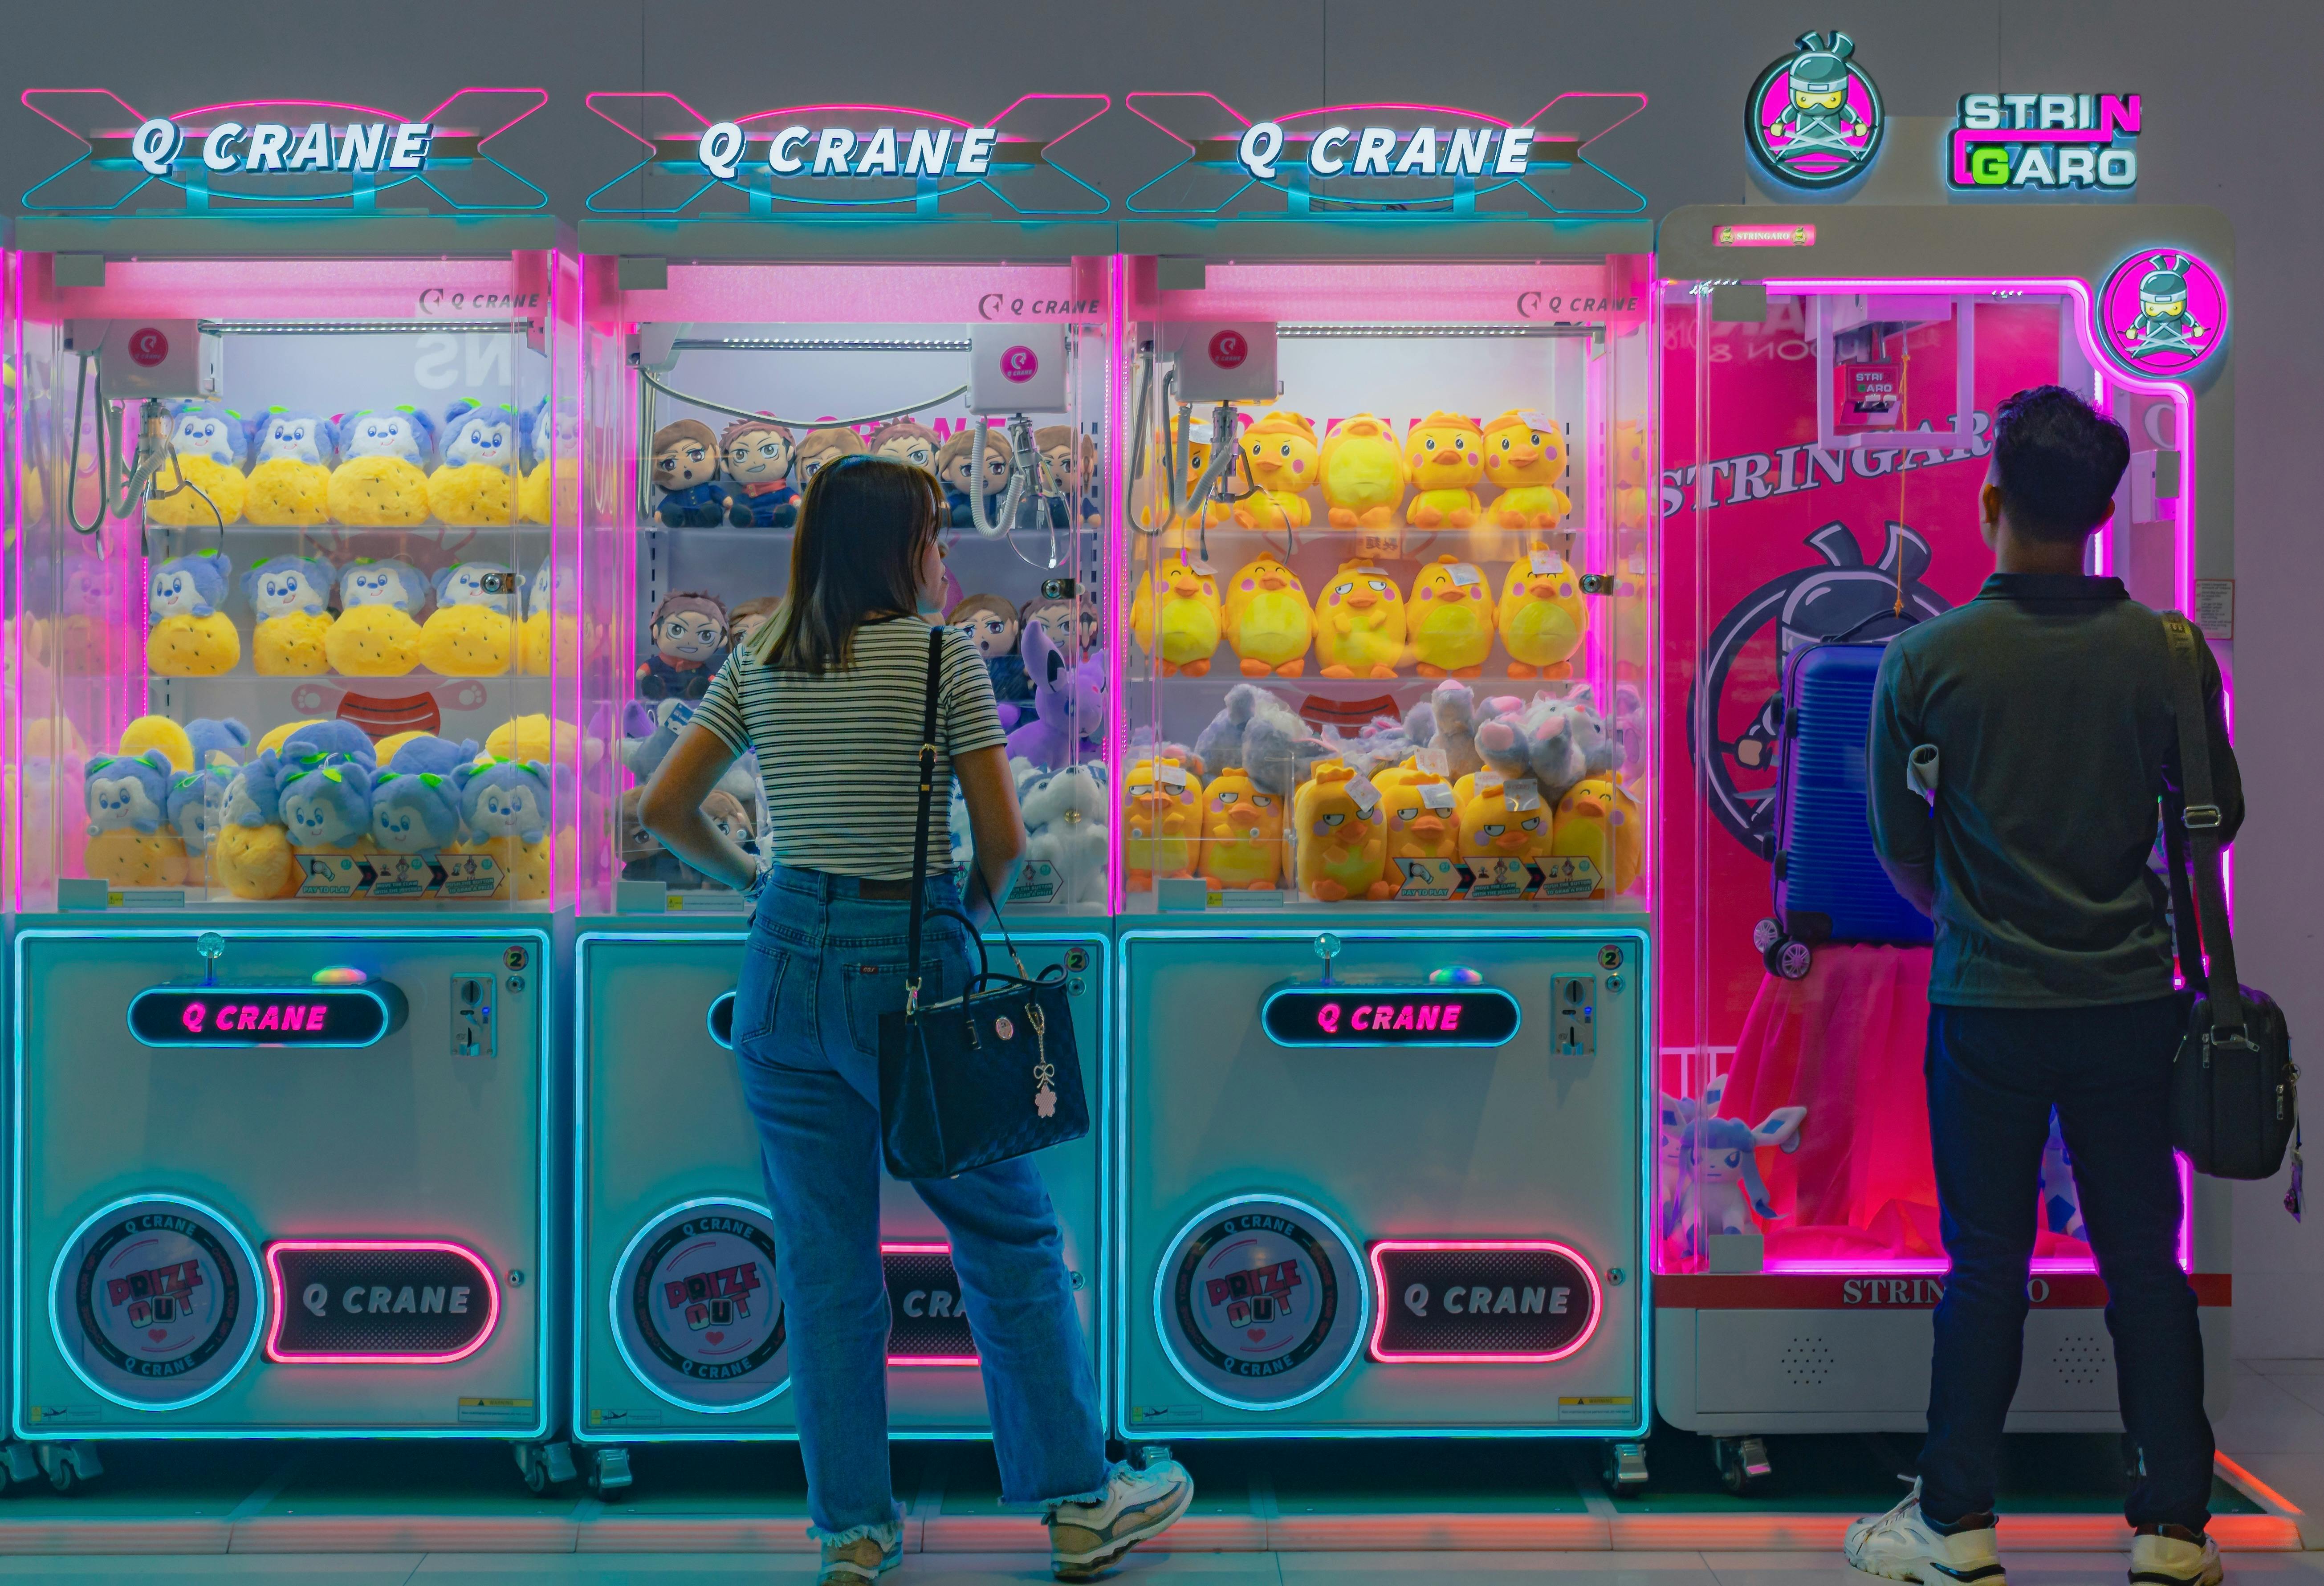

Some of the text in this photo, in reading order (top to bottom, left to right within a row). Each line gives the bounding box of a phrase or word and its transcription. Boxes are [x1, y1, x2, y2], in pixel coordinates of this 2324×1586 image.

[1963, 93, 2141, 132] STRIN
[132, 118, 434, 177] Q CRANE
[699, 122, 998, 178] Q CRANE
[1237, 122, 1535, 178] Q CRANE
[1971, 148, 2137, 185] GARO
[1737, 232, 1790, 240] STRINGARO
[452, 293, 540, 310] Q CRANE
[1011, 299, 1100, 316] Q CRANE
[1549, 297, 1638, 313] Q CRANE
[1856, 373, 1892, 381] STRI
[510, 952, 522, 967] 2
[1070, 954, 1083, 968] 2
[1605, 952, 1616, 965] 2
[183, 1003, 328, 1033] Q CRANE
[1318, 1003, 1462, 1033] Q CRANE
[126, 1216, 196, 1236] Q CRANE
[683, 1218, 754, 1238] Q CRANE
[1224, 1216, 1294, 1236] Q CRANE
[107, 1259, 203, 1307] PRIZE
[664, 1262, 761, 1309] PRIZE
[1206, 1259, 1302, 1307] PRIZE
[1844, 1279, 2049, 1304] STRINO
[128, 1287, 193, 1329] OUT
[303, 1283, 470, 1317] Q CRANE
[685, 1289, 750, 1331] OUT
[902, 1289, 971, 1318] CRA
[1226, 1287, 1292, 1328] OUT
[1404, 1283, 1571, 1317] Q CRANE
[126, 1355, 195, 1375] Q CRANE
[682, 1358, 752, 1378] Q CRANE
[1224, 1355, 1294, 1375] Q CRANE
